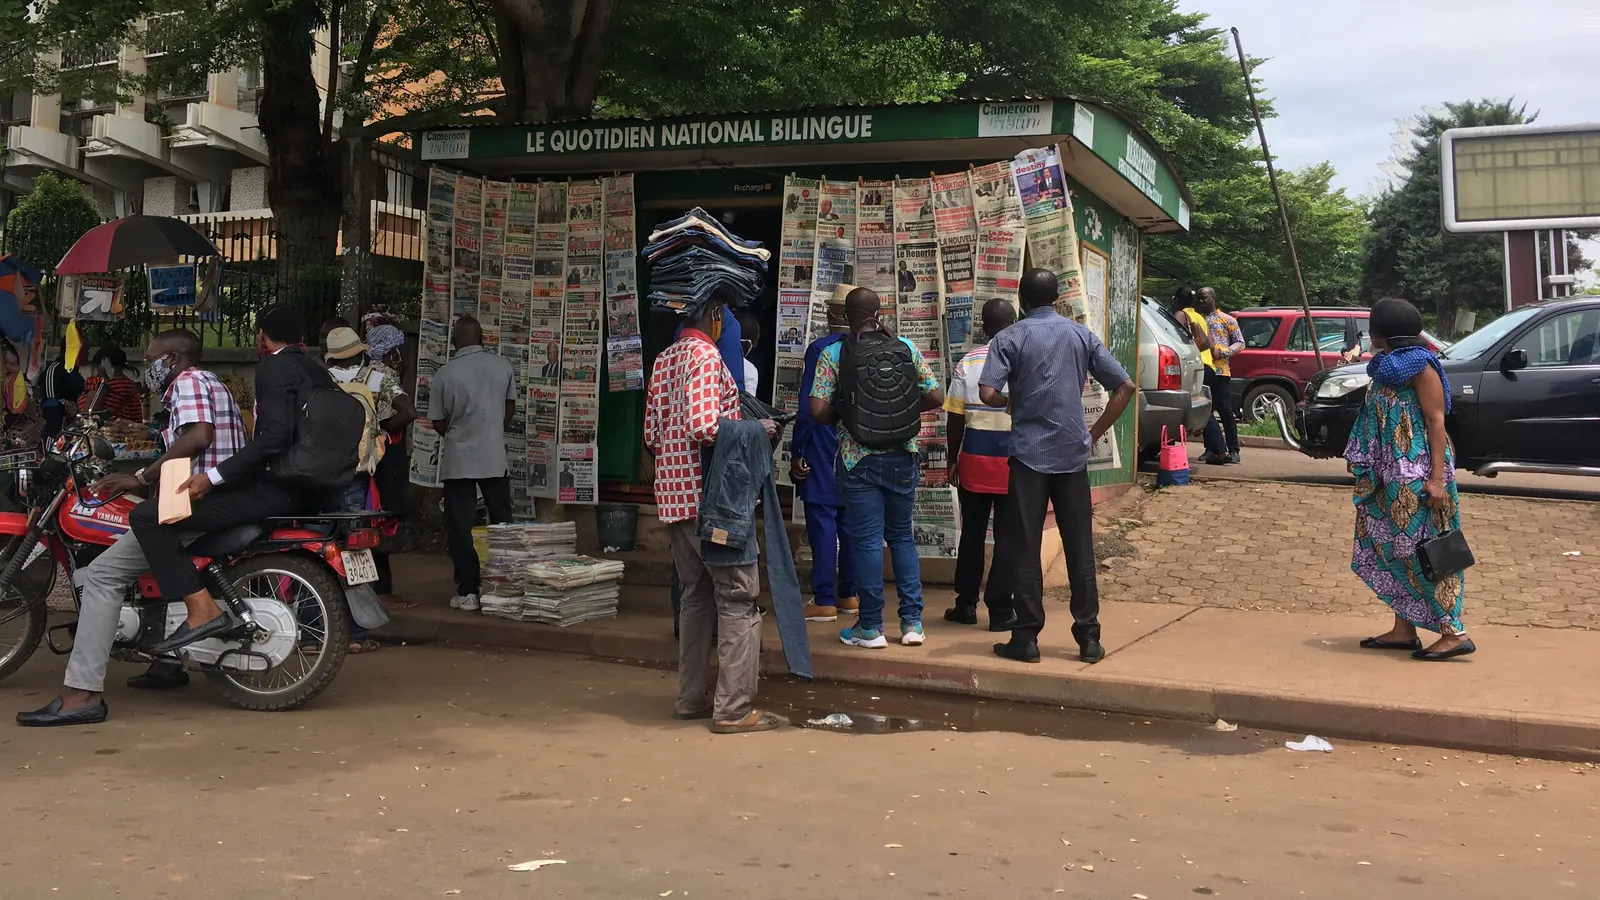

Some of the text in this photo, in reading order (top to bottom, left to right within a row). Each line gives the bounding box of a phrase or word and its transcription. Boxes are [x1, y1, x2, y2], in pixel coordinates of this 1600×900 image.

[982, 103, 1041, 116] Cameroon
[426, 132, 466, 141] Cameroon
[526, 114, 873, 155] LE QUOTIDIEN NATIONAL BILINGUE
[1015, 160, 1046, 175] destiny
[733, 183, 764, 193] Recharge
[896, 250, 905, 259] Le
[81, 278, 115, 287] Orange
[567, 302, 585, 310] Leader
[956, 310, 965, 320] prix
[528, 388, 557, 399] Tribune
[97, 511, 124, 524] YAMAHA
[348, 565, 369, 582] 3940
